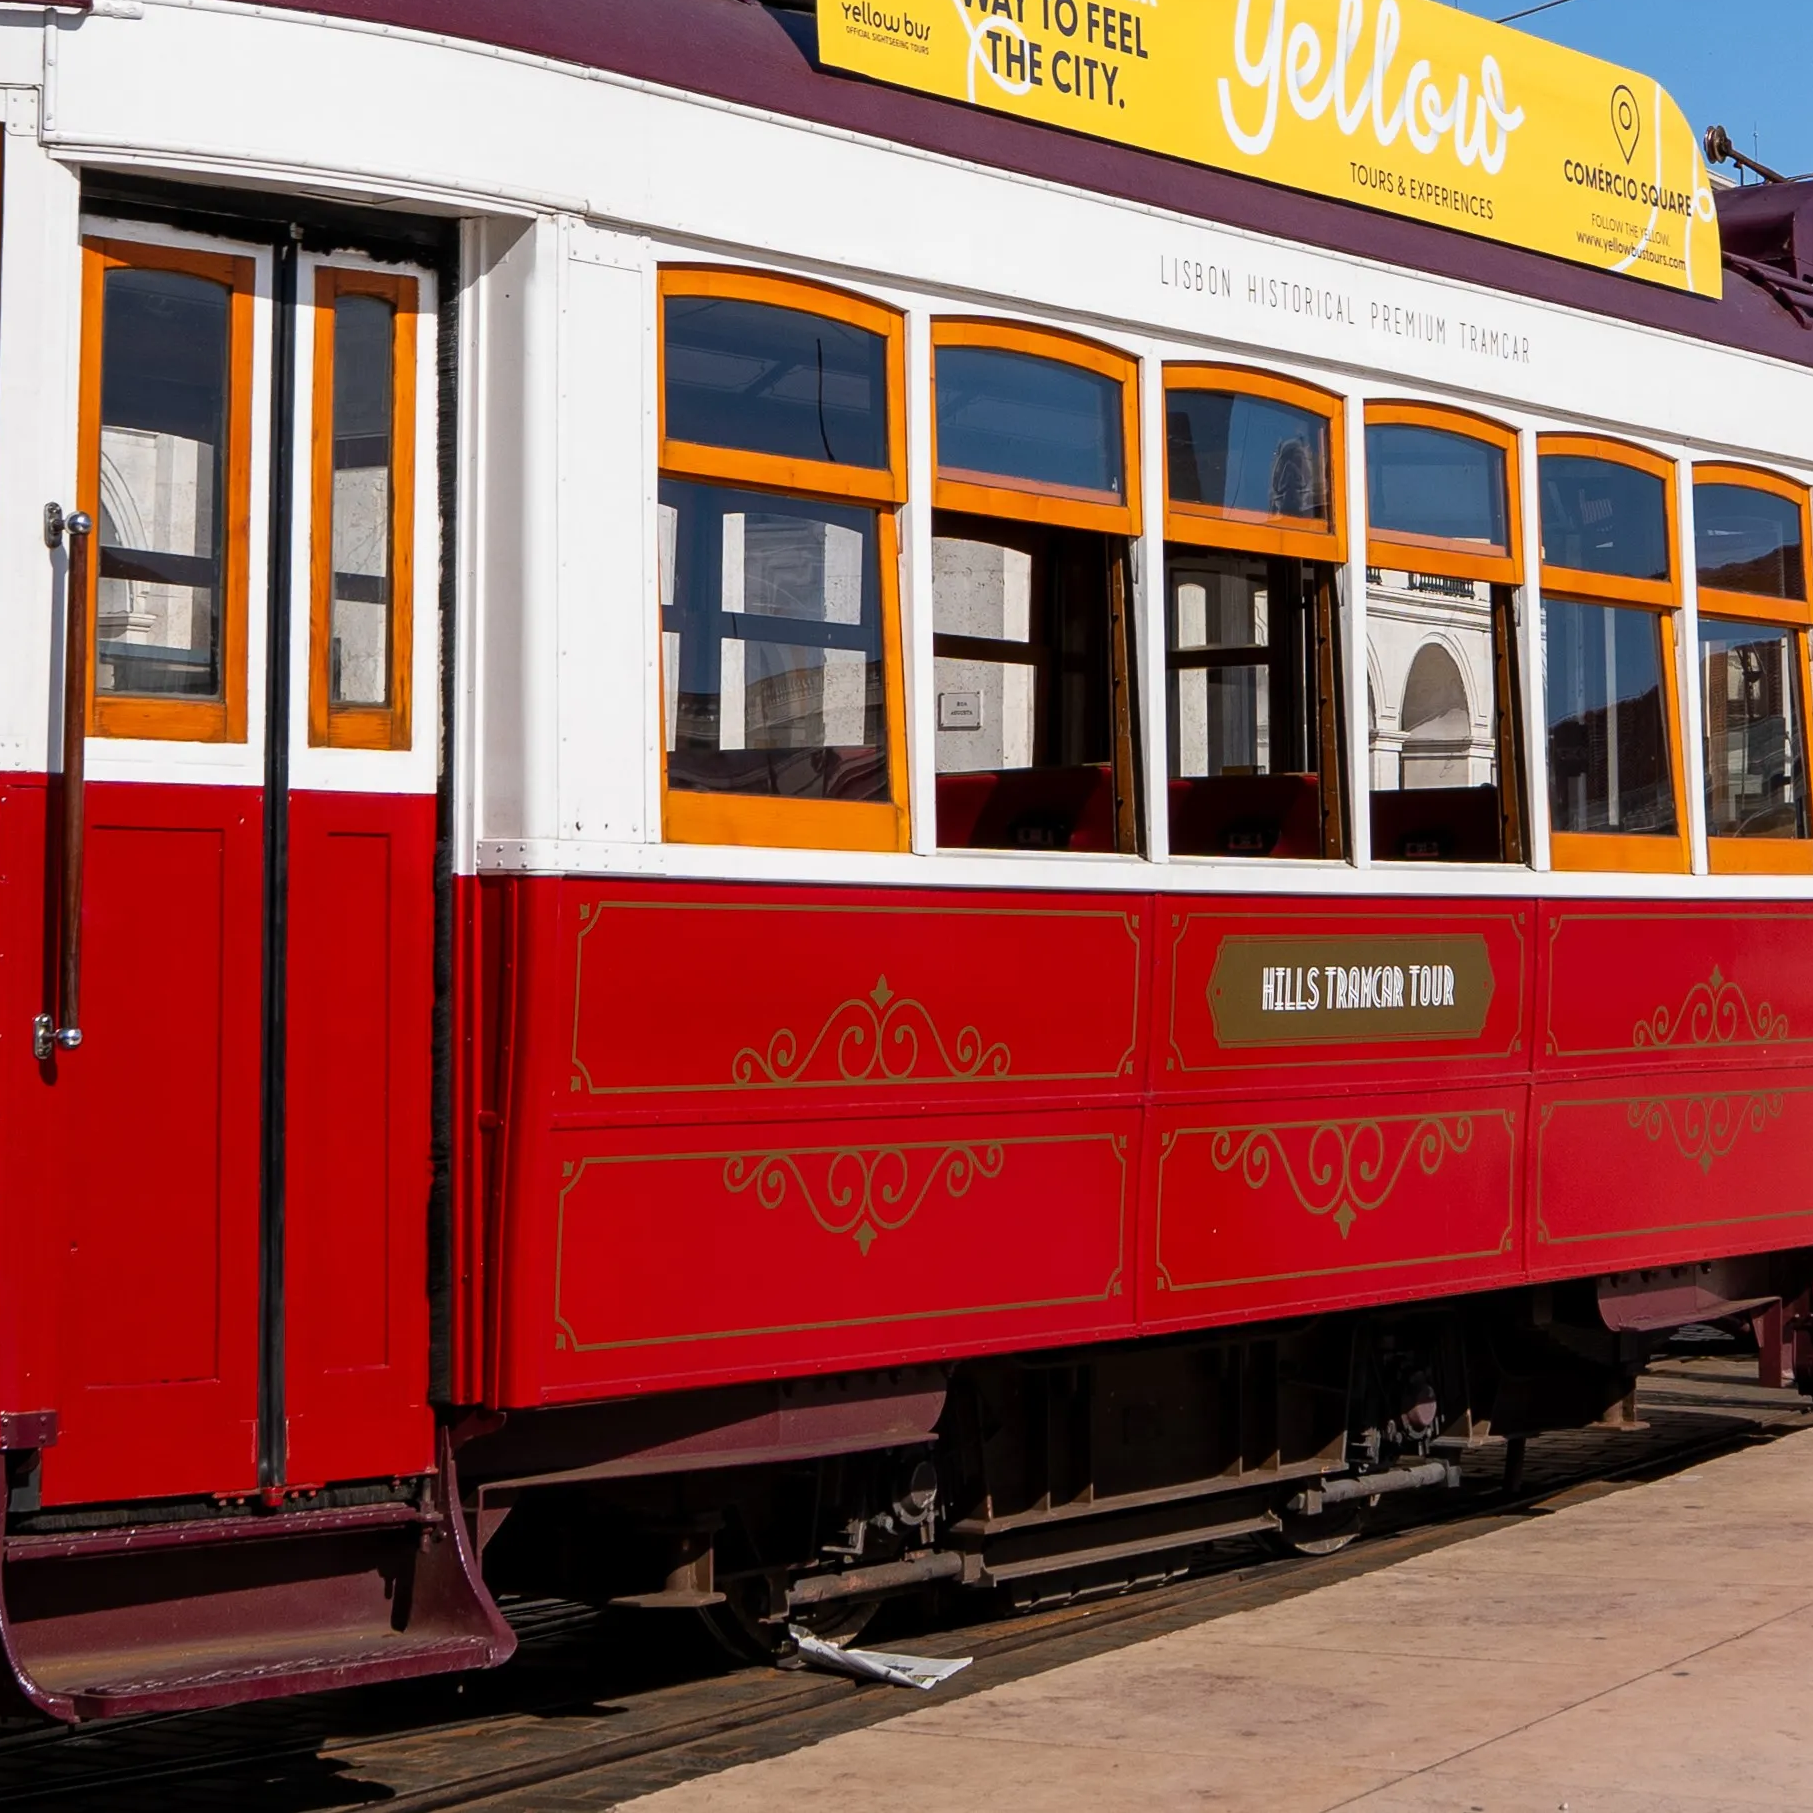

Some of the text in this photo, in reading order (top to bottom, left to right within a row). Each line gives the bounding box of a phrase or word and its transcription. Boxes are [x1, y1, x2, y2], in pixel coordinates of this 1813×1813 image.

[846, 25, 871, 40] OFFICIAL
[910, 42, 929, 56] TOURS
[904, 12, 930, 41] bus
[1086, 1, 1149, 59] FEEL
[987, 30, 1125, 110] THE CITY.
[1350, 161, 1495, 220] TOURS & EXPERIENCES
[1563, 158, 1693, 218] COMÉRCIO SQUARE
[1576, 231, 1687, 271] www.yellowbustours.com
[1592, 213, 1624, 235] FOLLOW
[1625, 222, 1639, 239] THE
[1160, 254, 1531, 364] LISBON HISTORICAL PREMIUM TRAMCAR
[1262, 964, 1455, 1011] HILLS TRAMCAR TOUR
